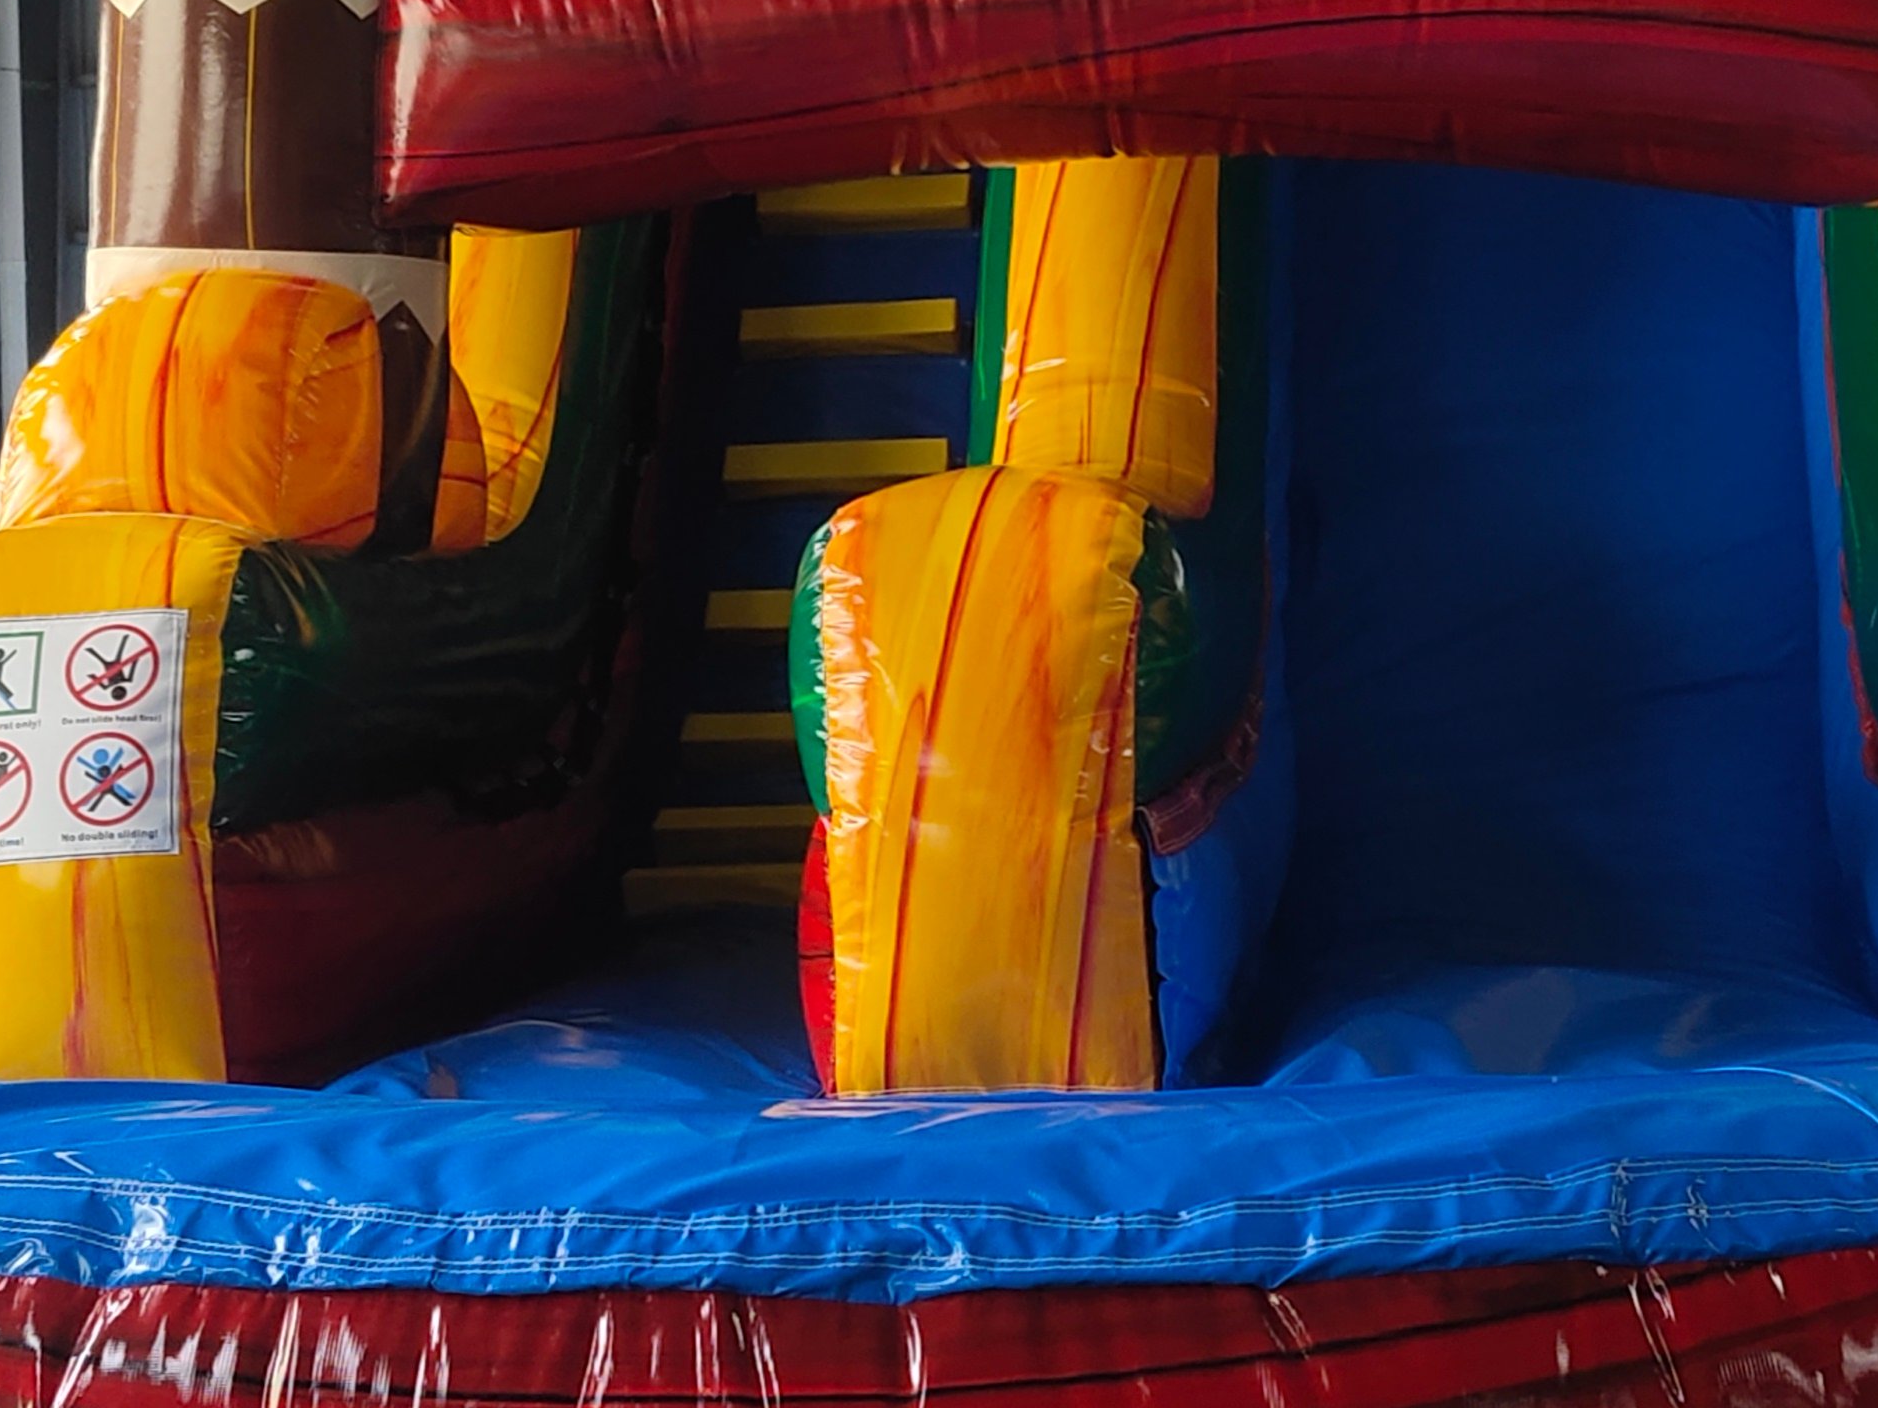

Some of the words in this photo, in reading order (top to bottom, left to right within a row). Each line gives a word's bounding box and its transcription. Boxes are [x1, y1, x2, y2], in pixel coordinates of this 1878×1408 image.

[115, 714, 137, 722] head
[61, 833, 76, 842] No
[77, 831, 115, 842] double
[117, 829, 159, 840] sliding!
